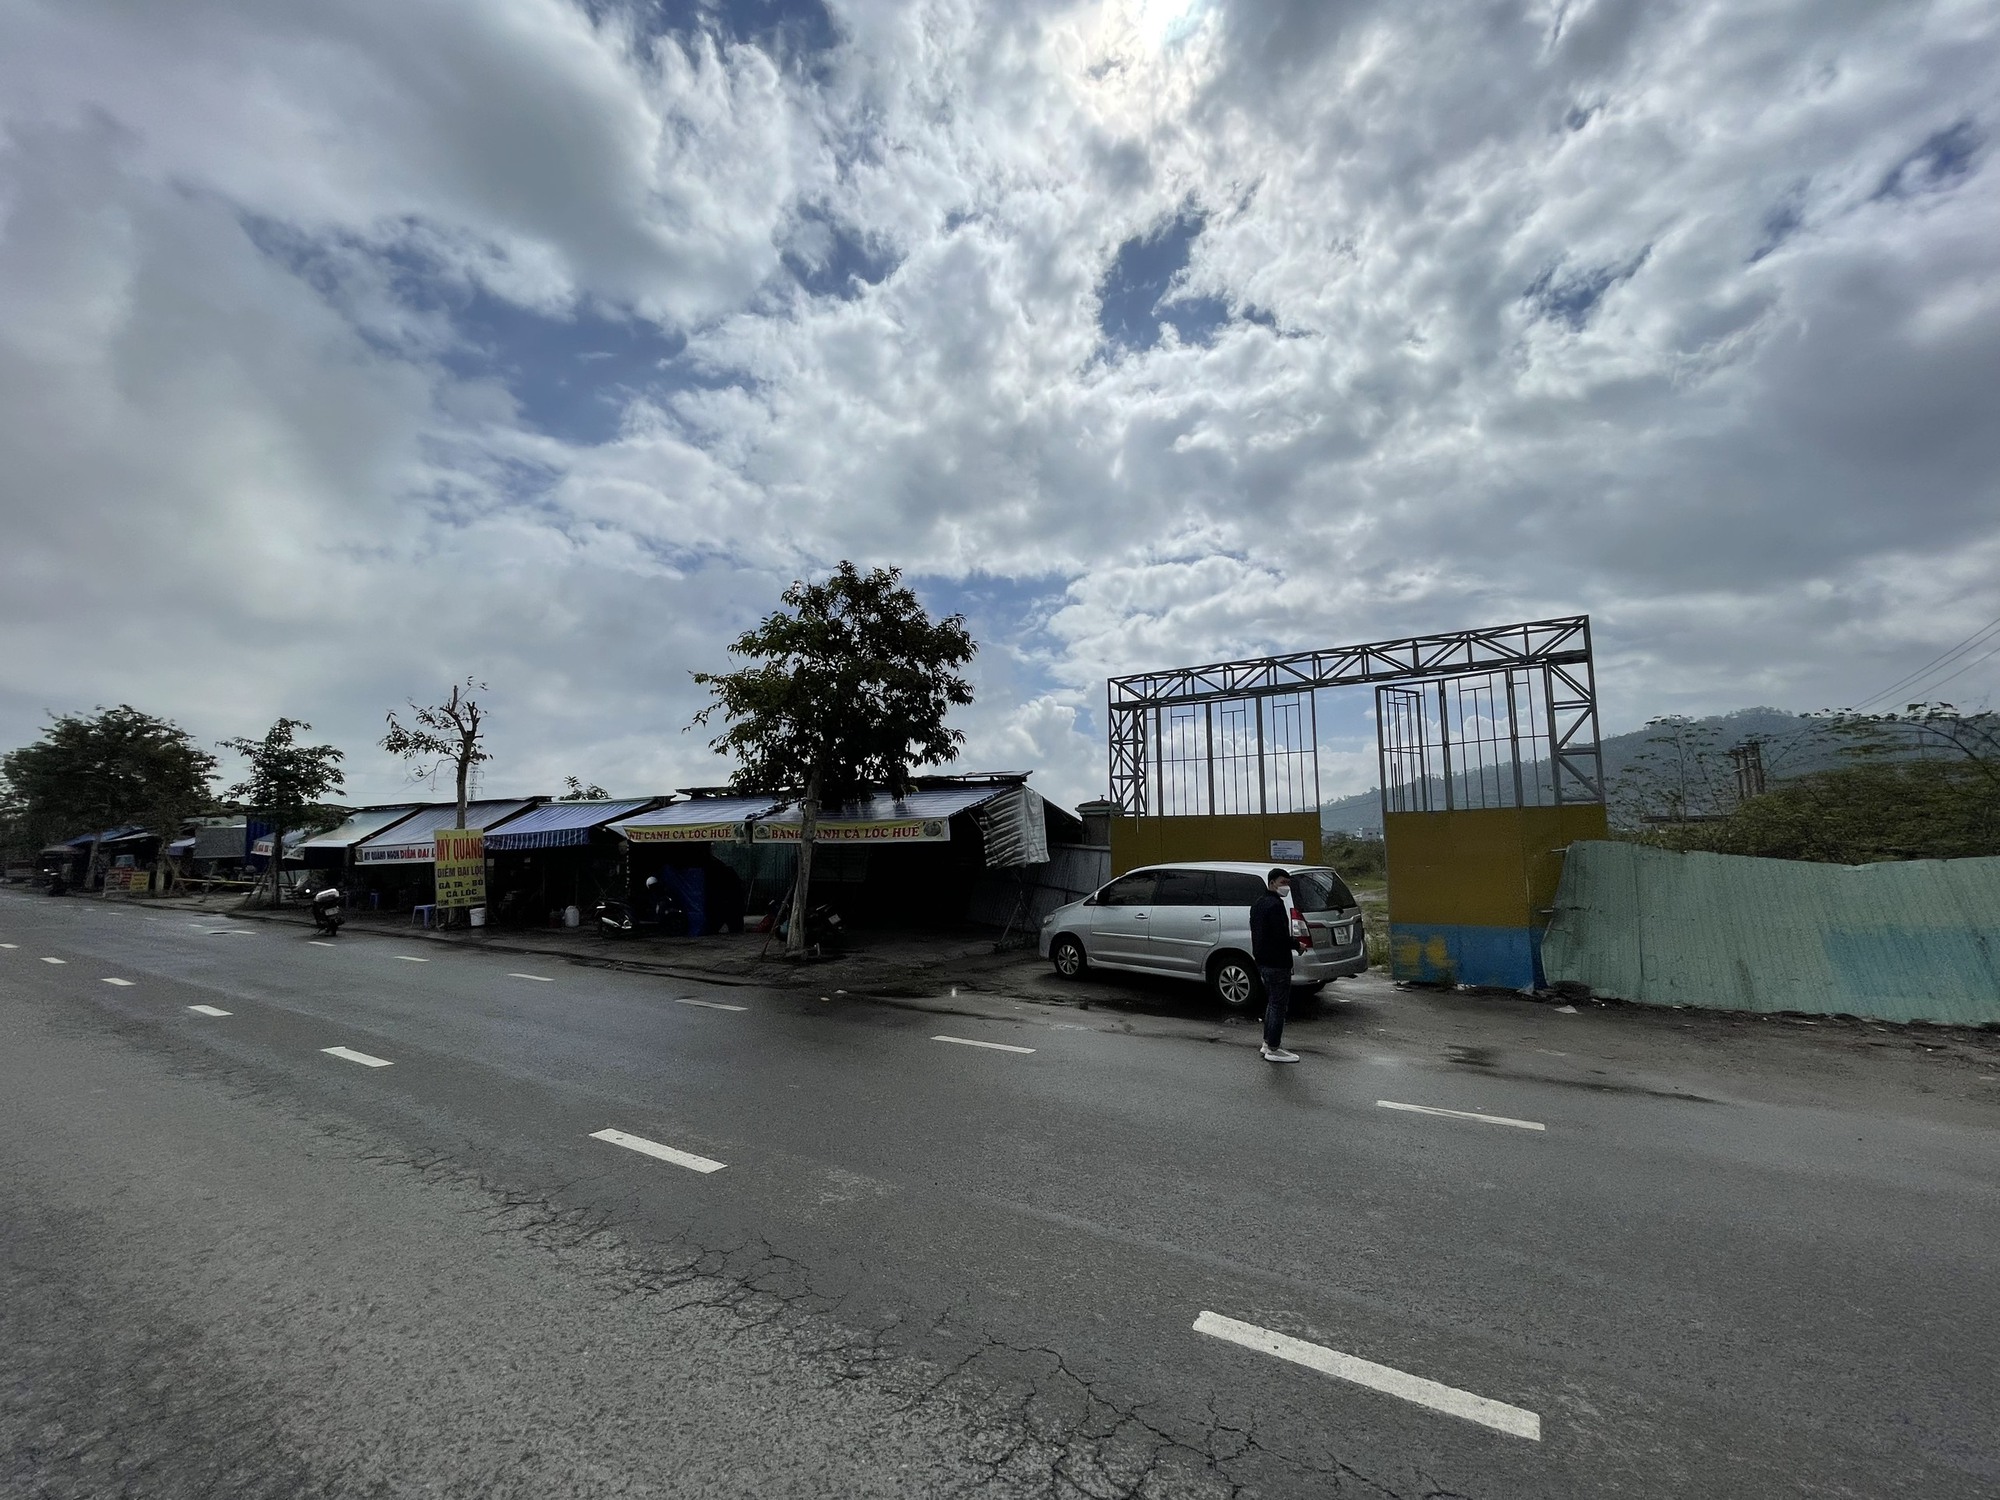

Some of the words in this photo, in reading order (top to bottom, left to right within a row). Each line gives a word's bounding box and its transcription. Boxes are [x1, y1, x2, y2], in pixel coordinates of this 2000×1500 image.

[644, 830, 670, 840] CANH
[710, 824, 732, 838] HUẾ
[815, 829, 840, 839] ANH
[844, 826, 861, 839] CÁ
[865, 825, 889, 838] LÓC
[892, 822, 921, 837] HUẾ
[453, 831, 483, 862] QUẢNG
